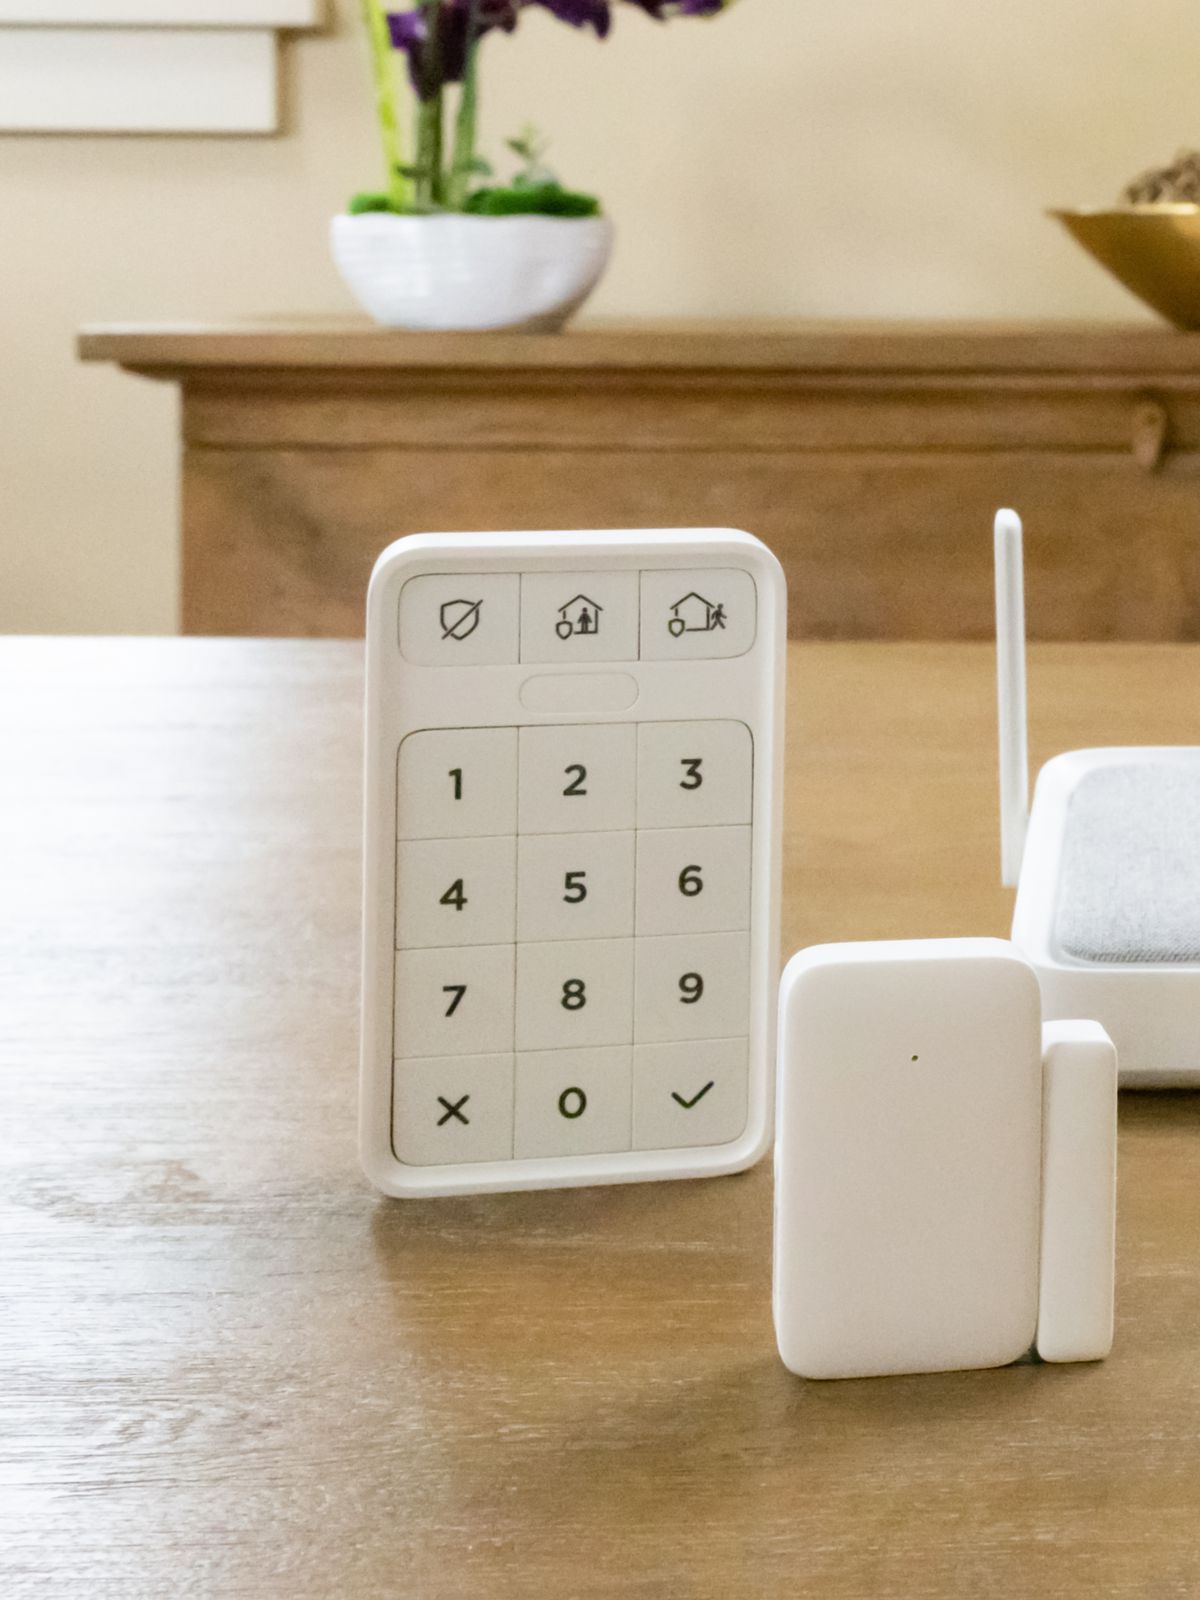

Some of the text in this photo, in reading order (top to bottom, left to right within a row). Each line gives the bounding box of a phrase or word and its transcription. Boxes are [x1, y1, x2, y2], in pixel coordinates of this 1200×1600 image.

[448, 758, 703, 801] 1 2 3
[439, 864, 704, 912] 4 5 6
[442, 972, 704, 1018] 7 8 9
[558, 1086, 587, 1120] 0
